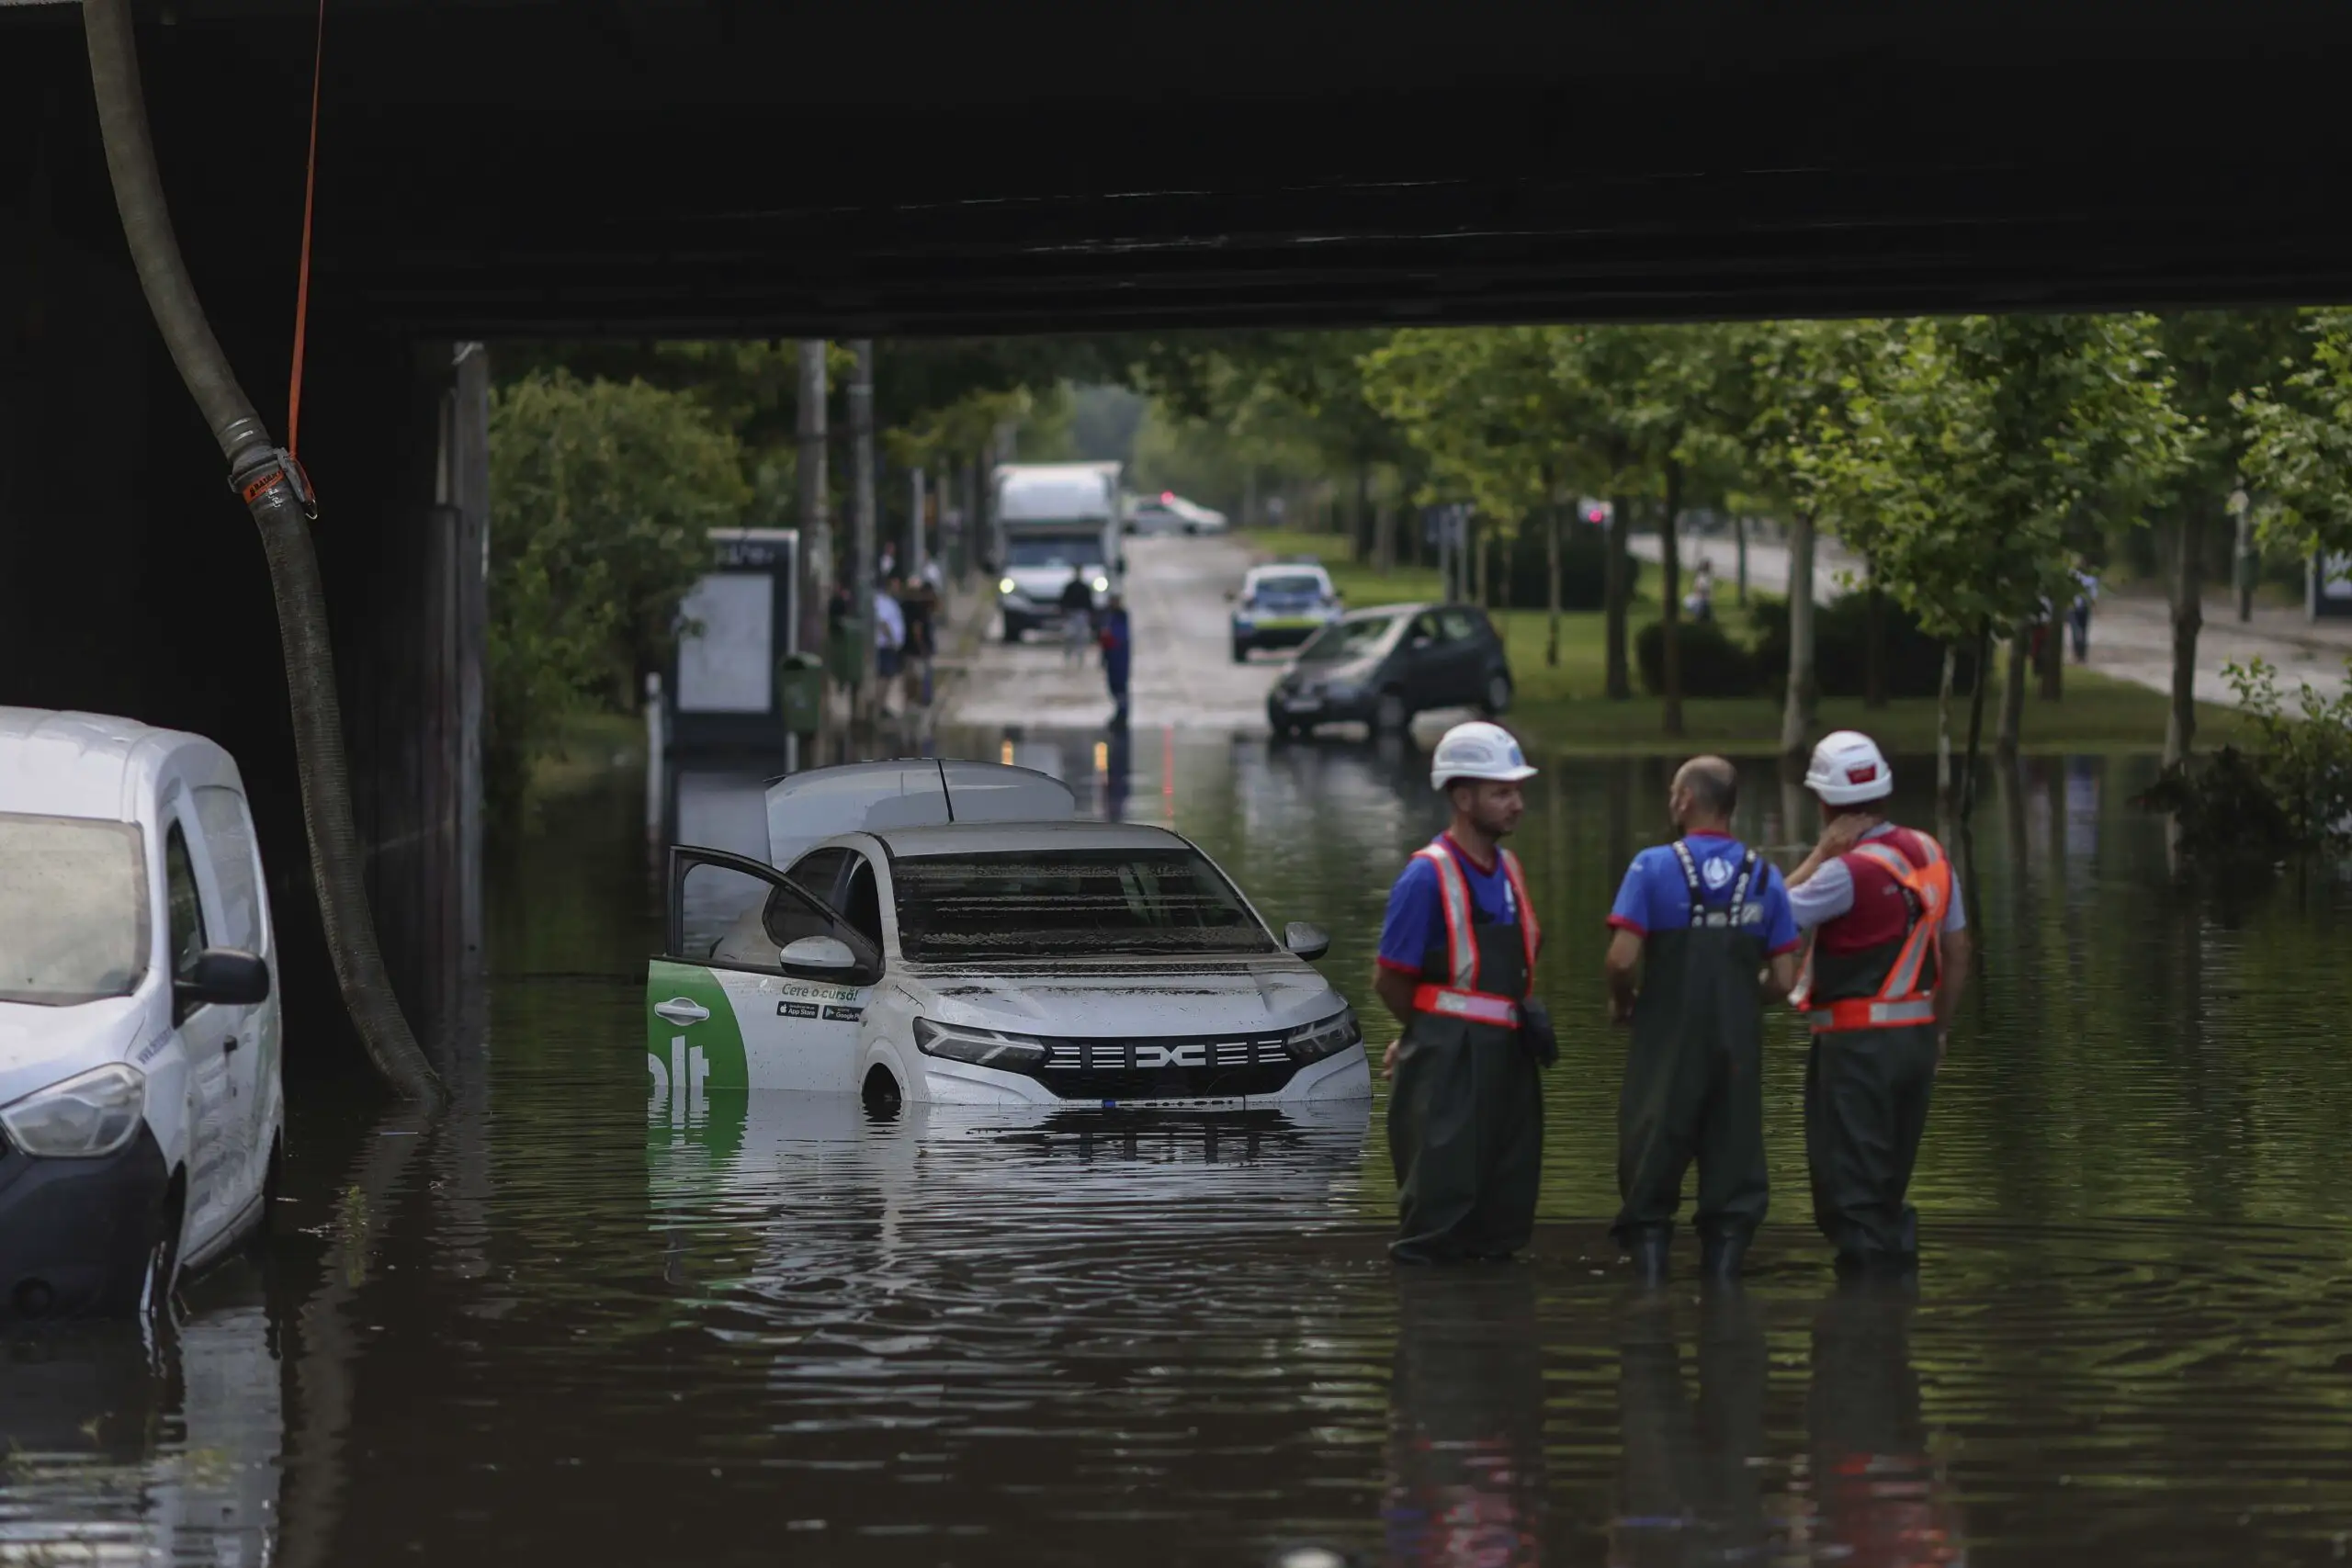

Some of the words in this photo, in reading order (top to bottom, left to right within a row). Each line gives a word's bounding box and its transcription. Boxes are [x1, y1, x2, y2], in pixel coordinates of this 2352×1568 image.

[782, 983, 808, 998] Cere
[821, 987, 859, 1002] cursă!
[787, 1008, 800, 1017] App
[800, 1009, 816, 1017] Store
[835, 1011, 854, 1021] Google
